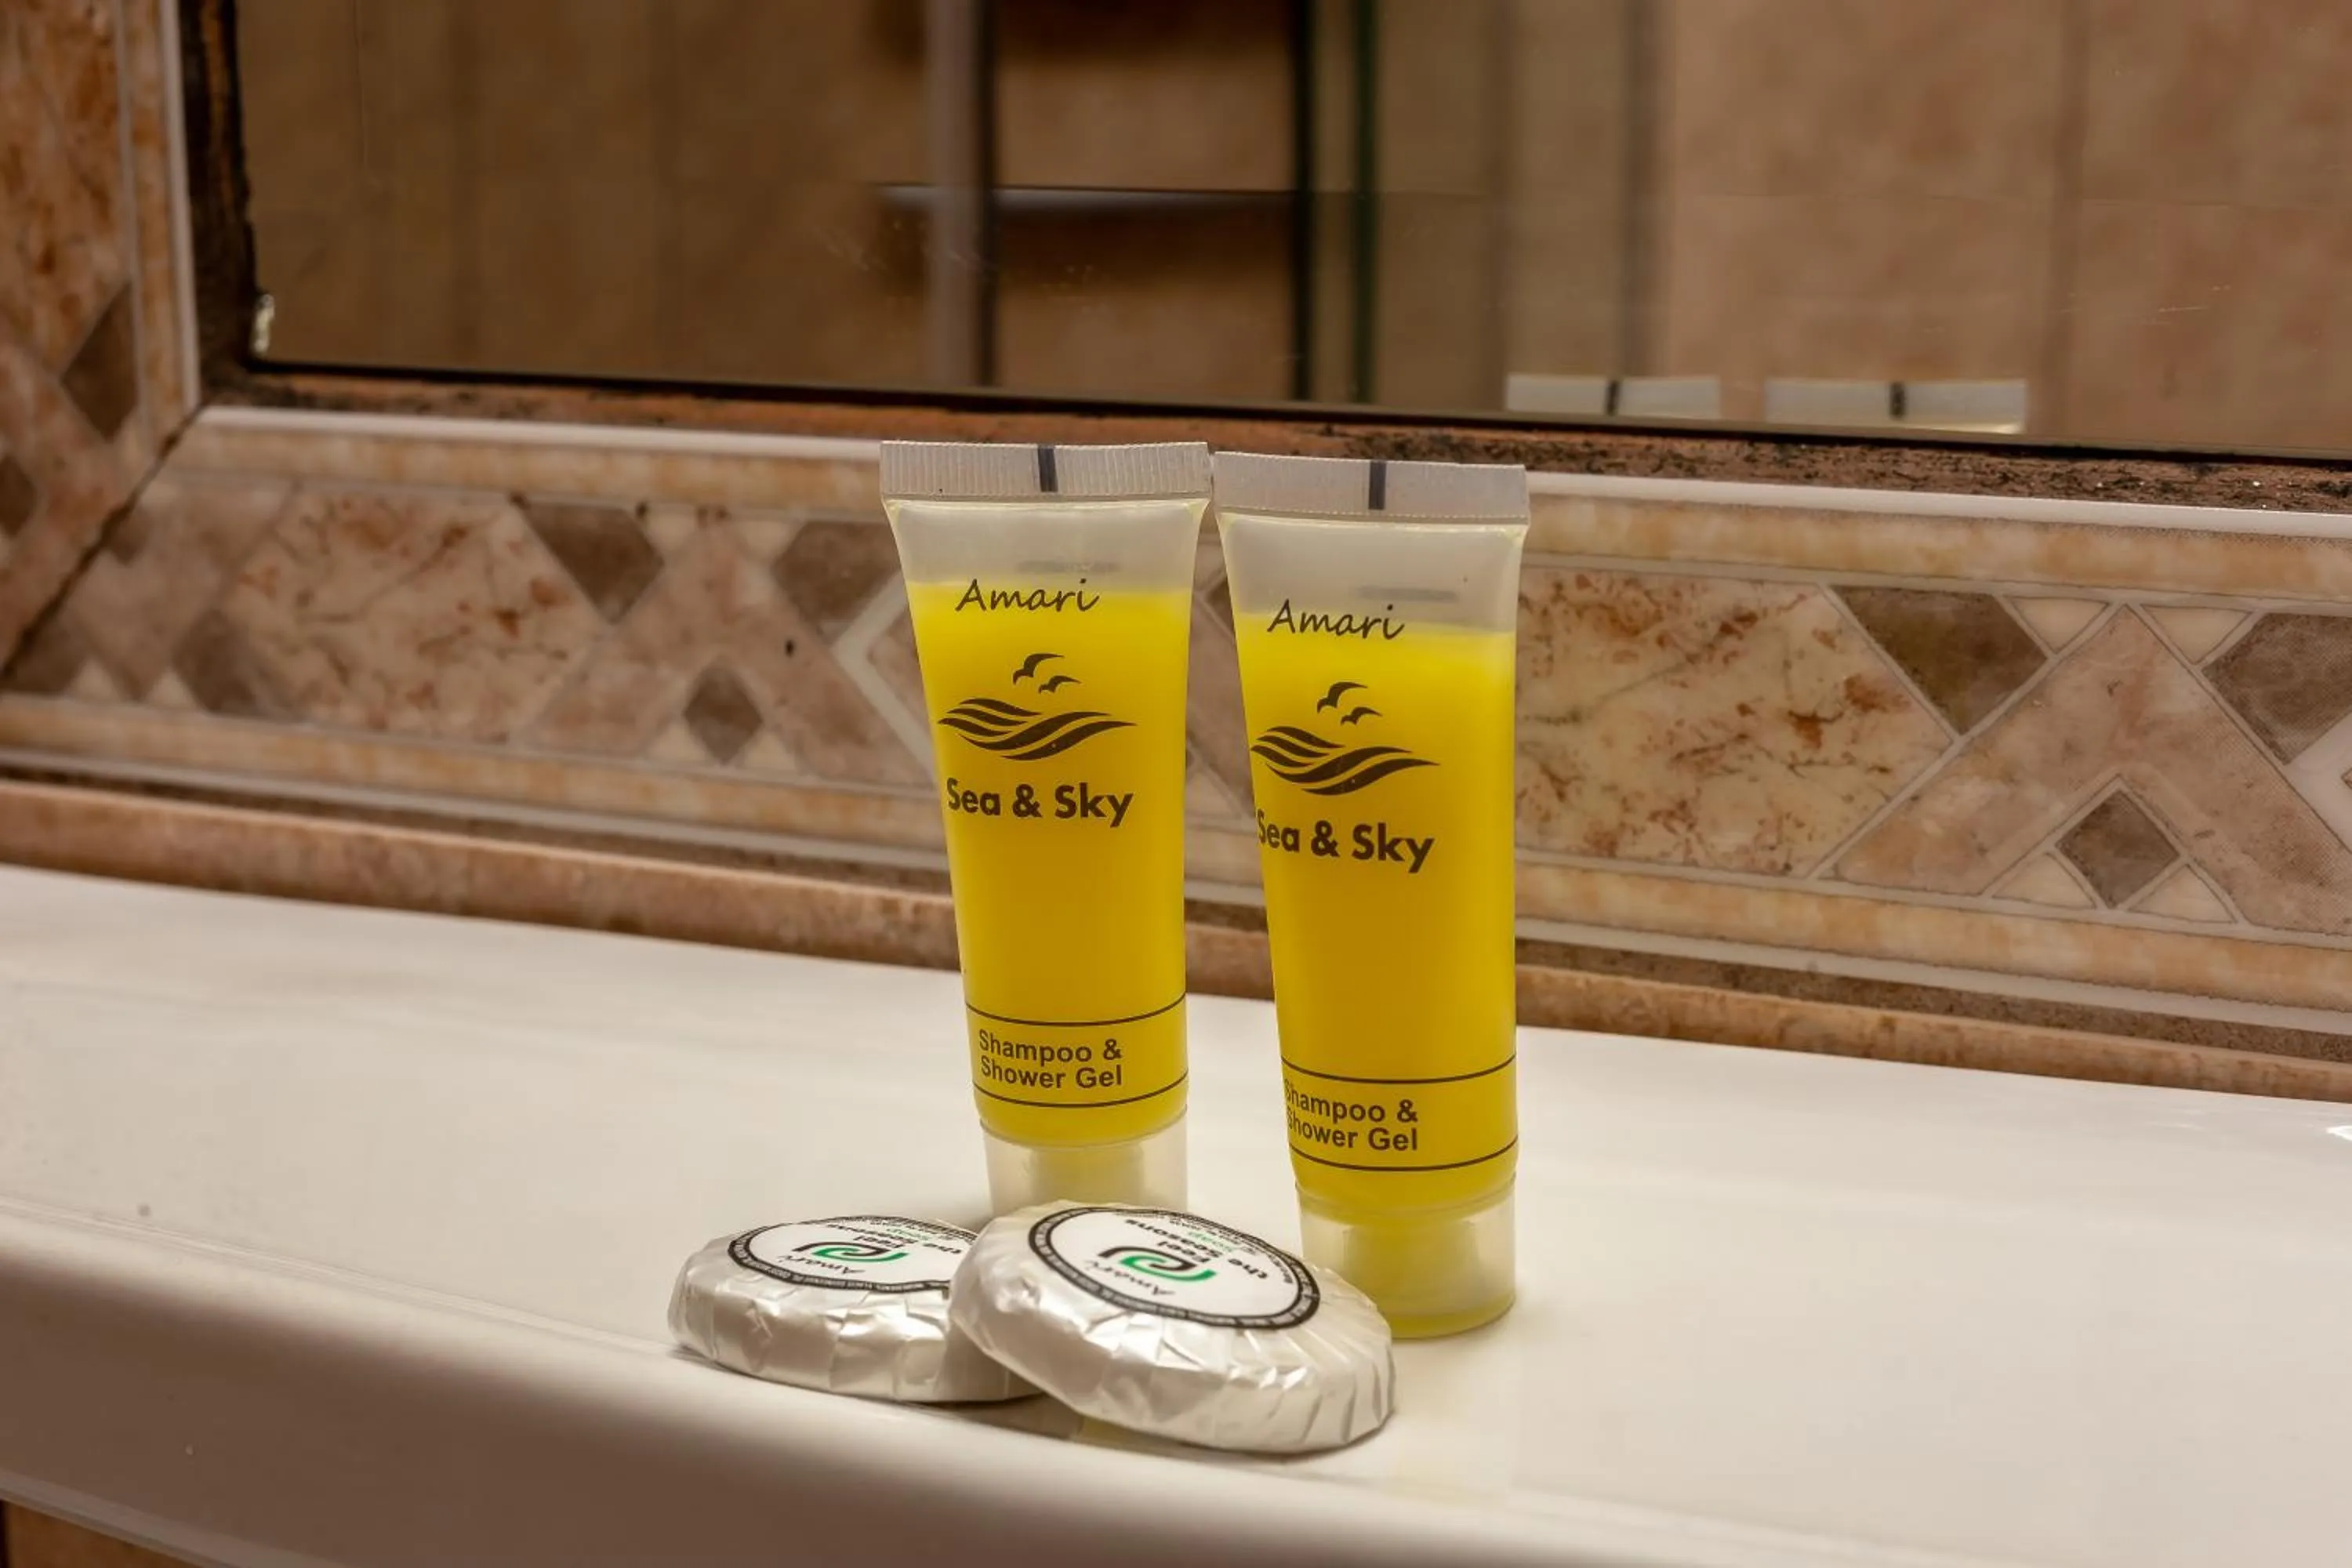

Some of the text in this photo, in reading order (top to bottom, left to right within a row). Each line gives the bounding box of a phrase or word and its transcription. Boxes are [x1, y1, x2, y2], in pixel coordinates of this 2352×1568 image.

[954, 578, 1100, 613] Amari
[1267, 599, 1406, 641] Amari
[946, 778, 1134, 828] Sea & Sky
[1256, 808, 1436, 874] Sea & Sky
[979, 1029, 1122, 1067] Shampoo &
[980, 1055, 1122, 1089] Shower Gel
[1284, 1078, 1418, 1124] Shampoo &
[1287, 1105, 1417, 1152] Shower Gel
[1227, 1258, 1269, 1279] the
